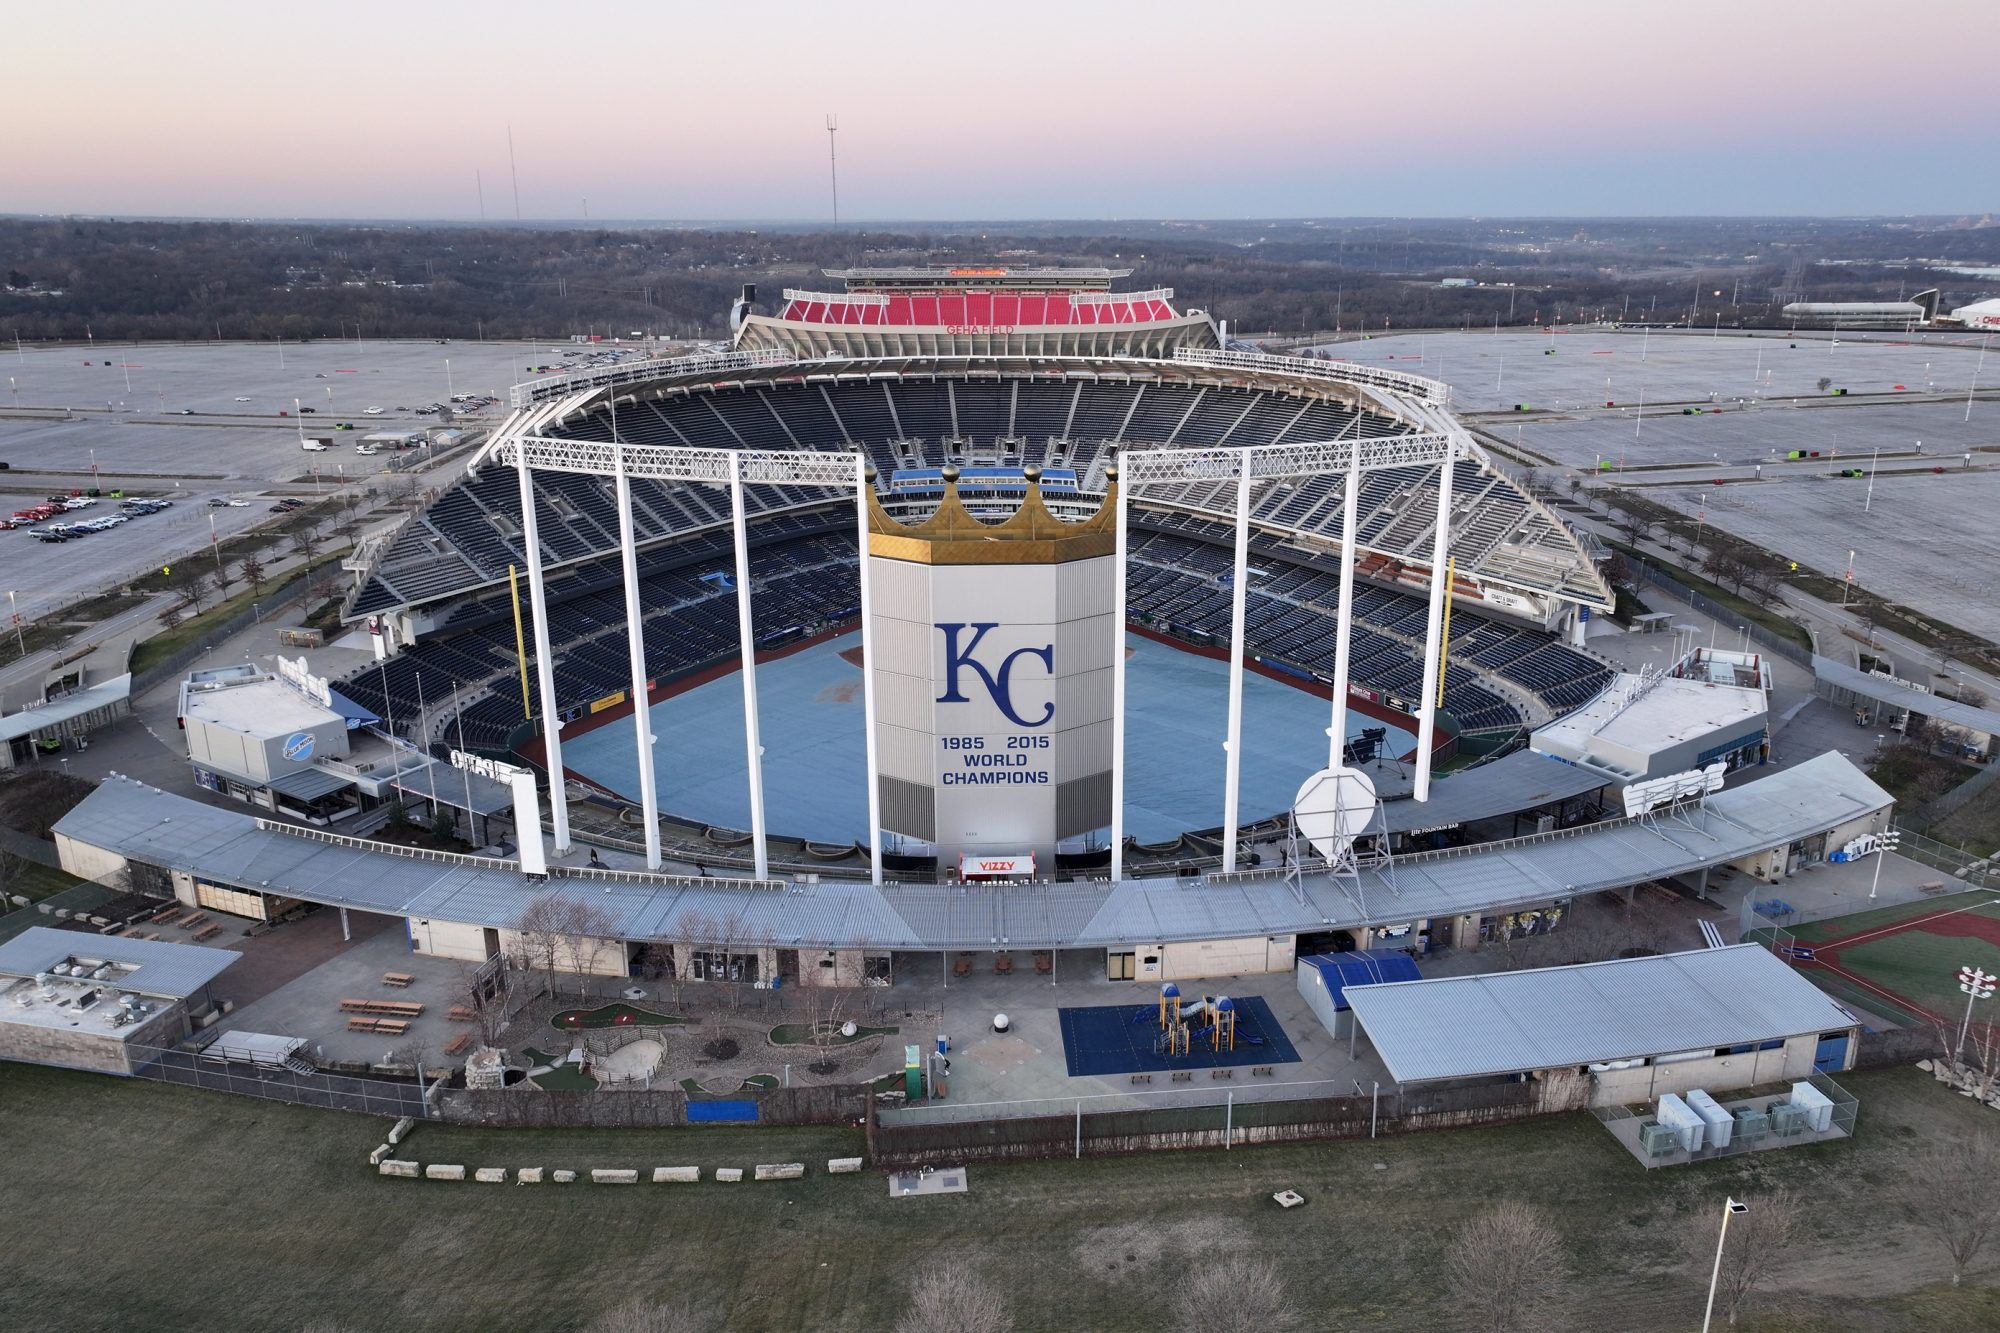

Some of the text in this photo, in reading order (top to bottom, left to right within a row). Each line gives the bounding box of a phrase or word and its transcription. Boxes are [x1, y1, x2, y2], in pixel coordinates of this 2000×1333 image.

[947, 325, 1014, 335] GEHA FIELD
[934, 623, 1055, 727] KC
[941, 736, 1049, 750] 1985 2015
[963, 754, 1028, 767] WORLD
[942, 771, 1049, 785] CHAMPIONS
